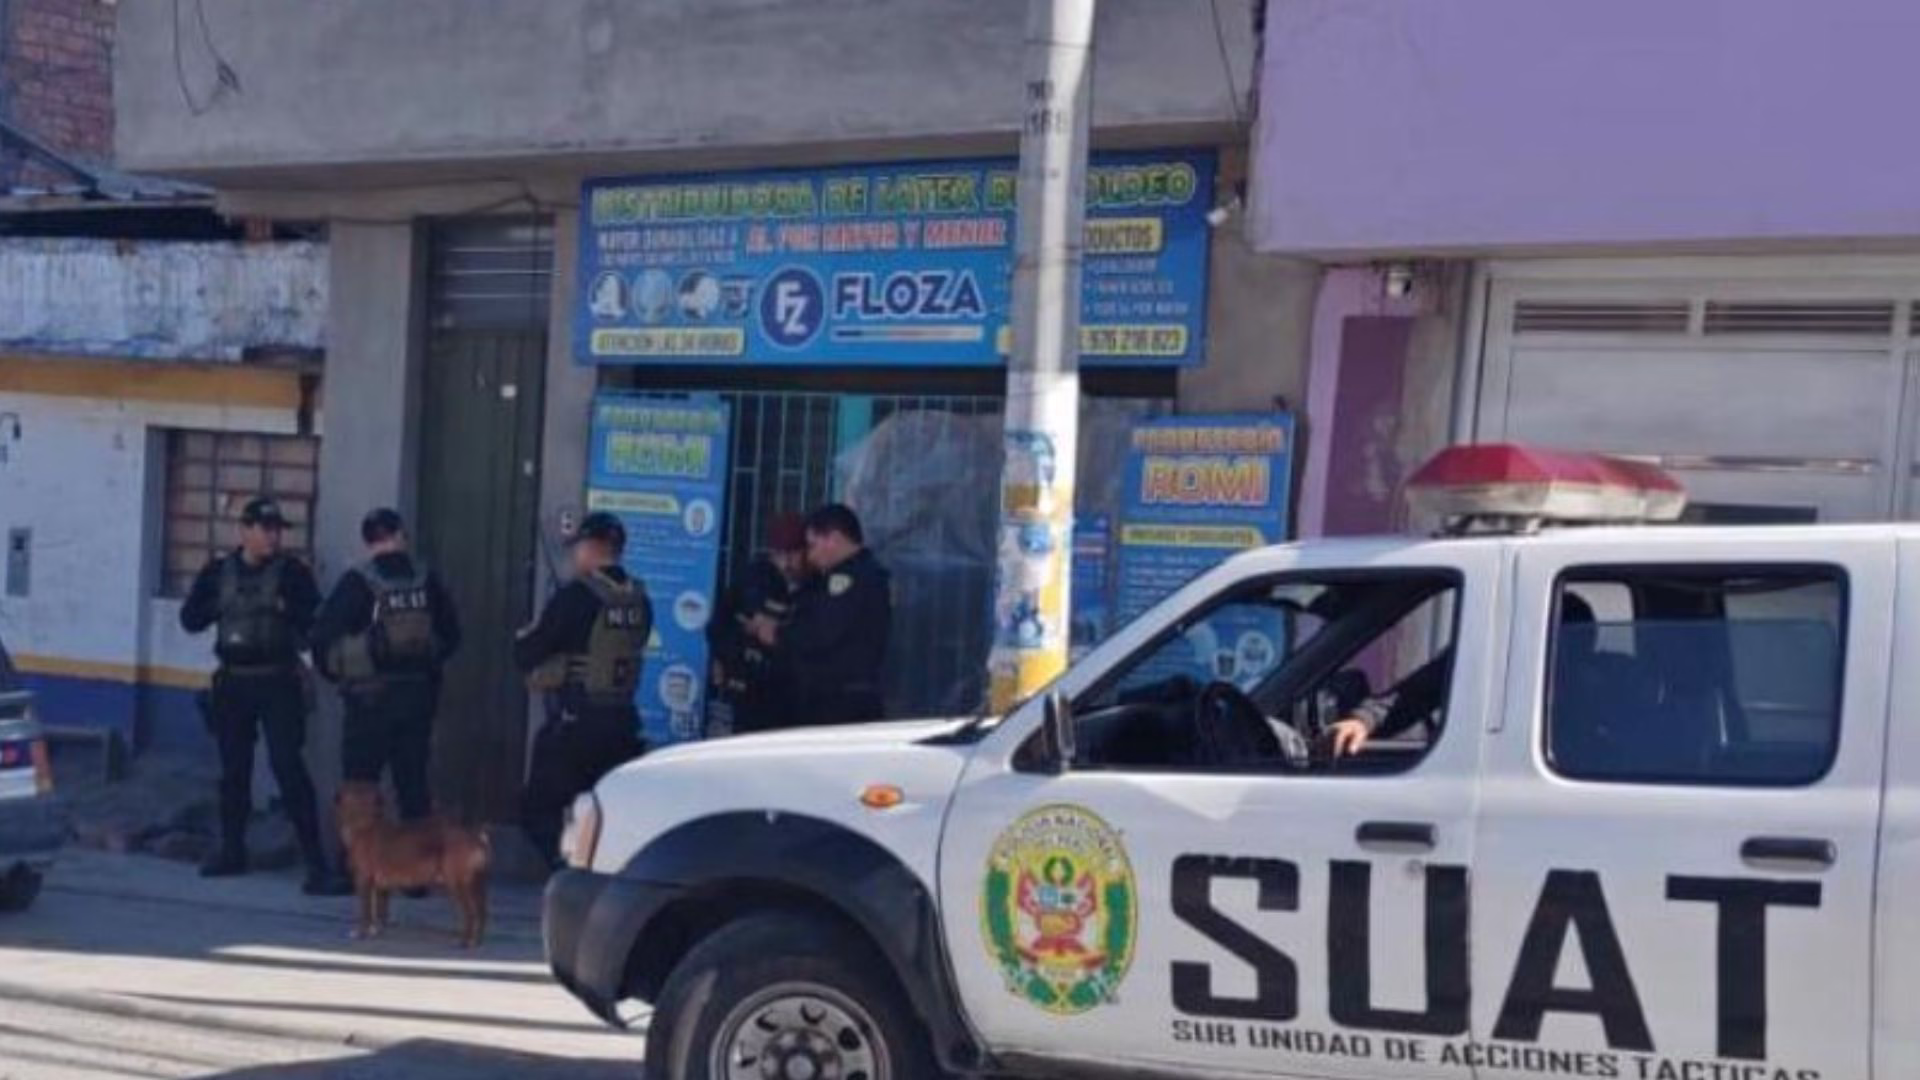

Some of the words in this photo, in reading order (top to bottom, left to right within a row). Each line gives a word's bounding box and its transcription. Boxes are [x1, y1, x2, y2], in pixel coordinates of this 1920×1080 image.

[834, 272, 984, 317] FLOZA
[1141, 456, 1271, 506] ROMI
[1171, 853, 1822, 1060] SUAT
[1172, 1020, 1236, 1046] SUB
[1249, 1025, 1371, 1057] UNIDAD
[1384, 1038, 1426, 1062] DE
[1440, 1042, 1618, 1077] ACCIONES
